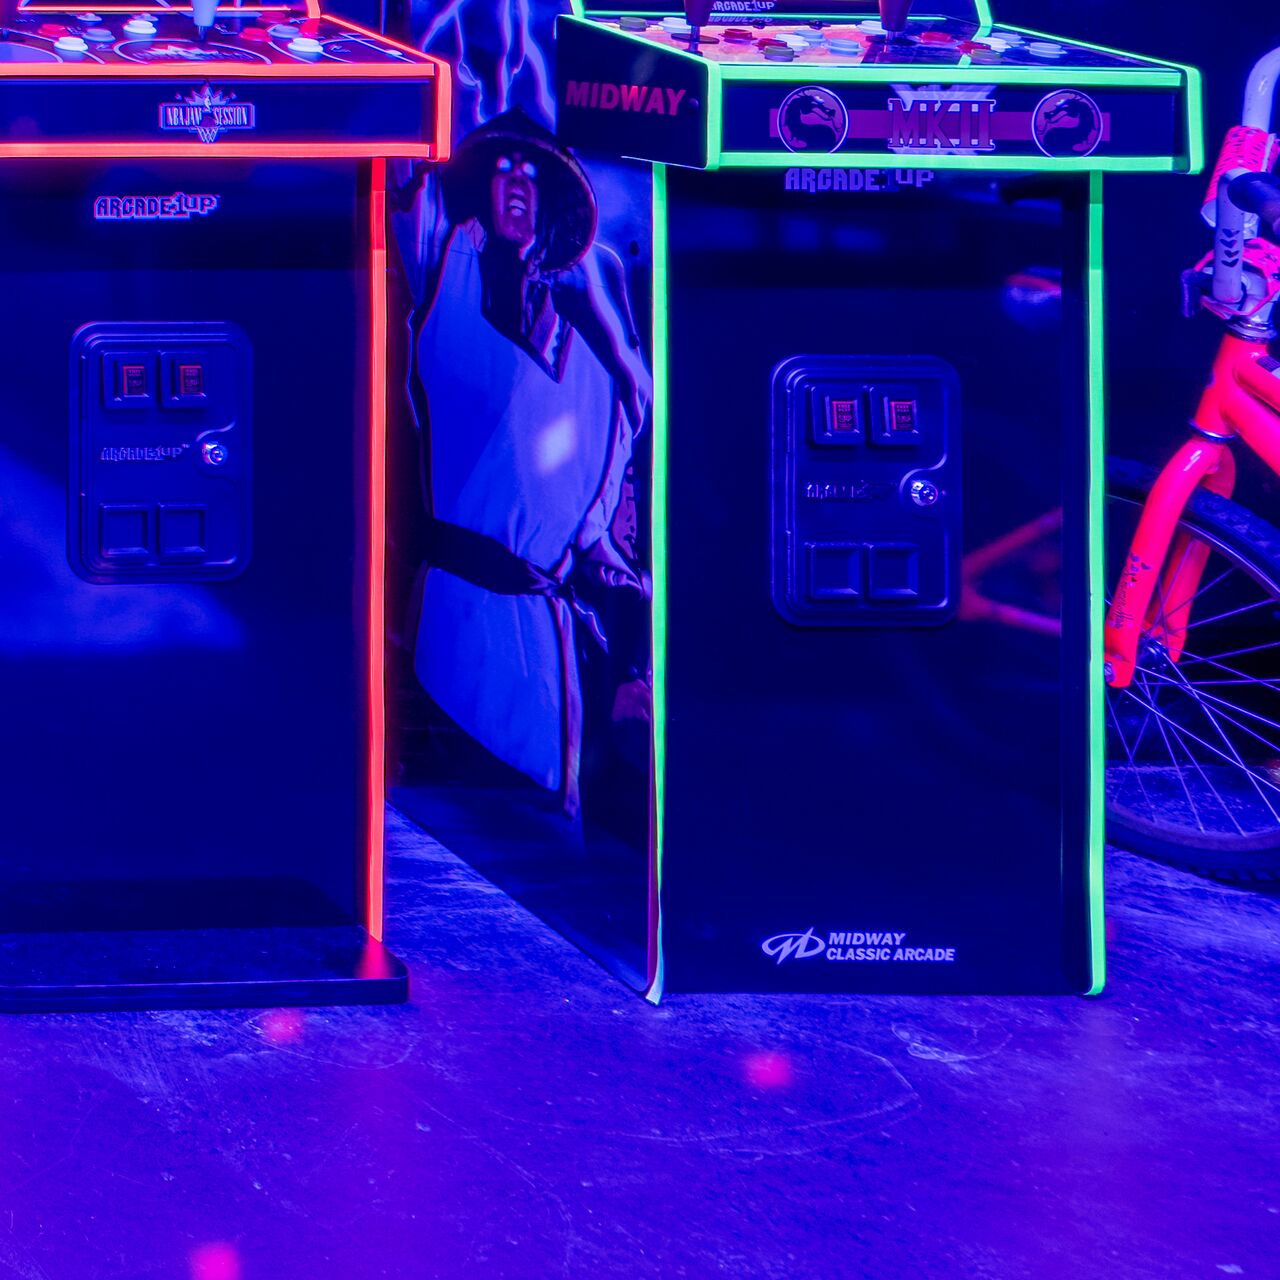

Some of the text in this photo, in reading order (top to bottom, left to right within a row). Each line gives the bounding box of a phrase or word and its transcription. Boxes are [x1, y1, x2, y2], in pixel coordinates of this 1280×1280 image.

[565, 80, 687, 117] MIDWAY
[213, 106, 248, 126] SESSION
[887, 98, 997, 151] MKII
[95, 192, 218, 219] ARCADE1UP
[828, 931, 907, 946] MIDWAY
[826, 947, 956, 962] CLASSIC ARCADE
